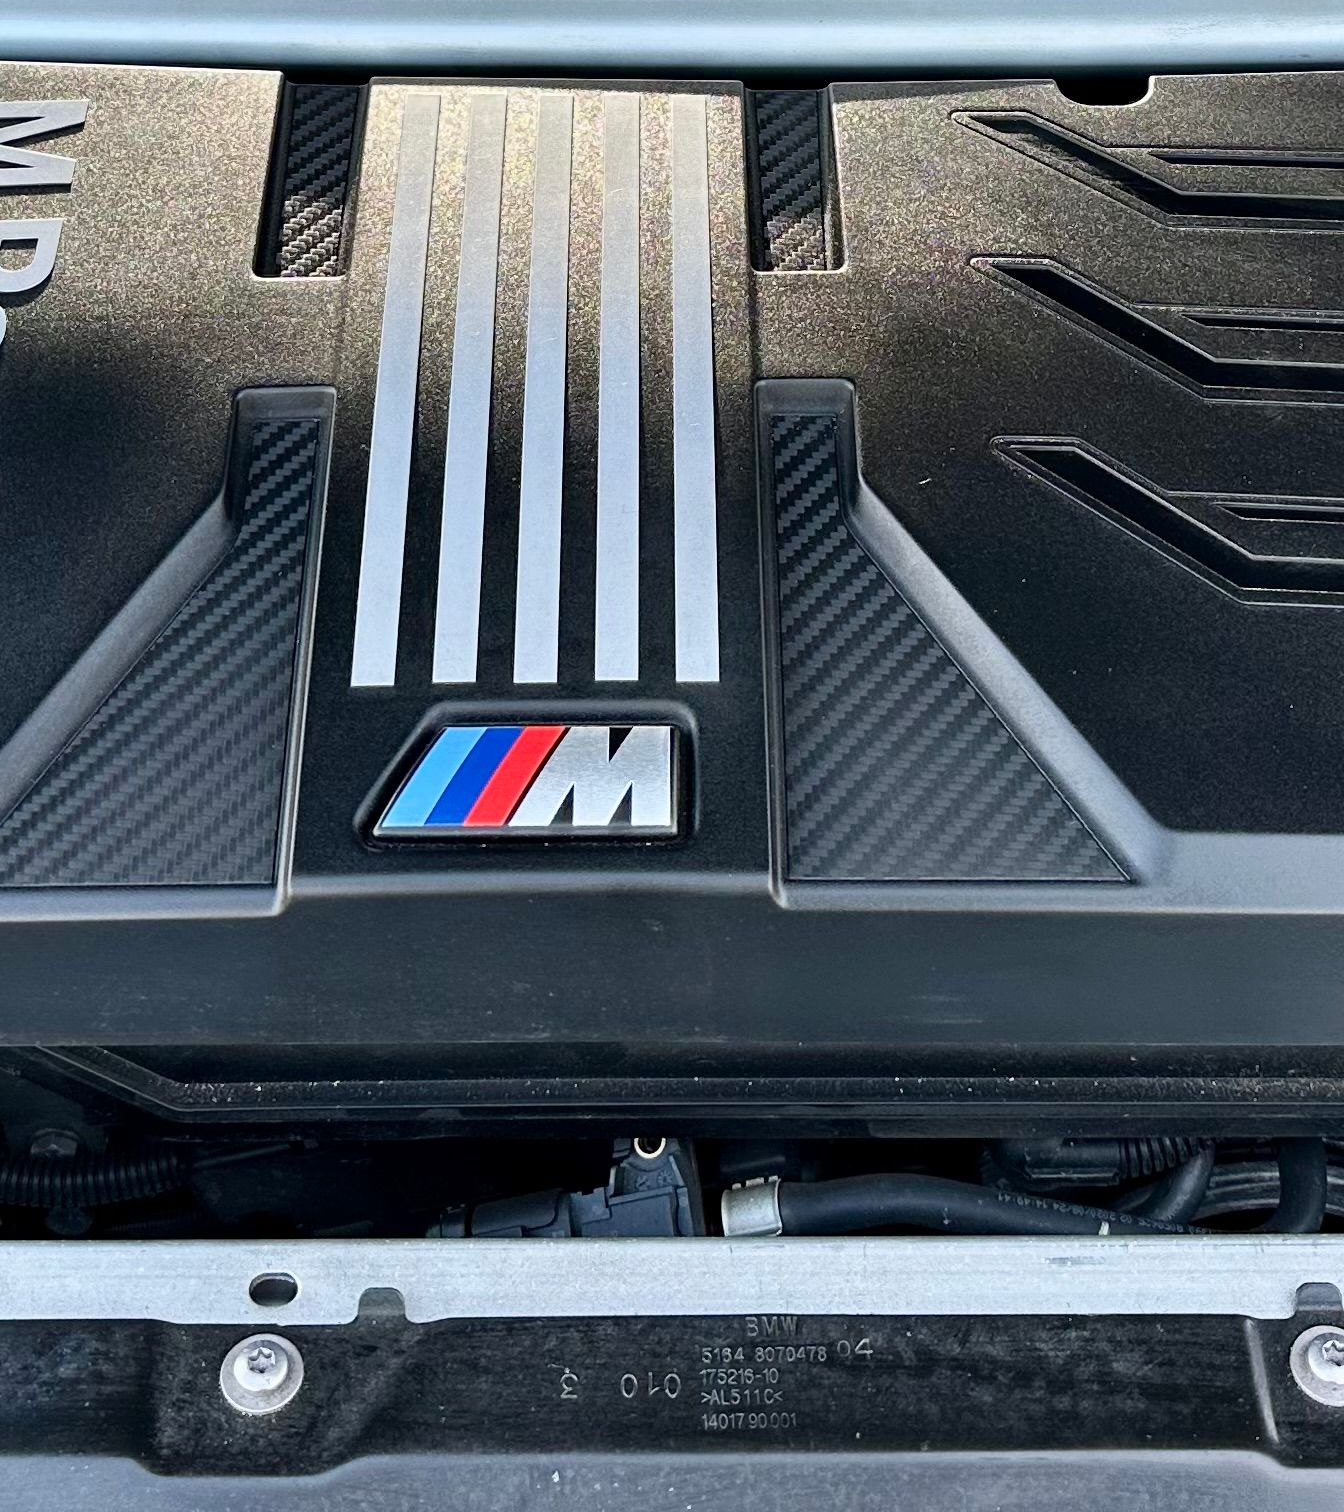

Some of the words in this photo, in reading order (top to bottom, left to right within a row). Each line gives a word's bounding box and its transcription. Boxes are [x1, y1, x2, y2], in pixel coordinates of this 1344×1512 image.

[744, 1315, 798, 1337] BMW
[755, 1345, 827, 1363] 8070478
[836, 1338, 874, 1360] 04
[699, 1367, 780, 1386] 175216-10
